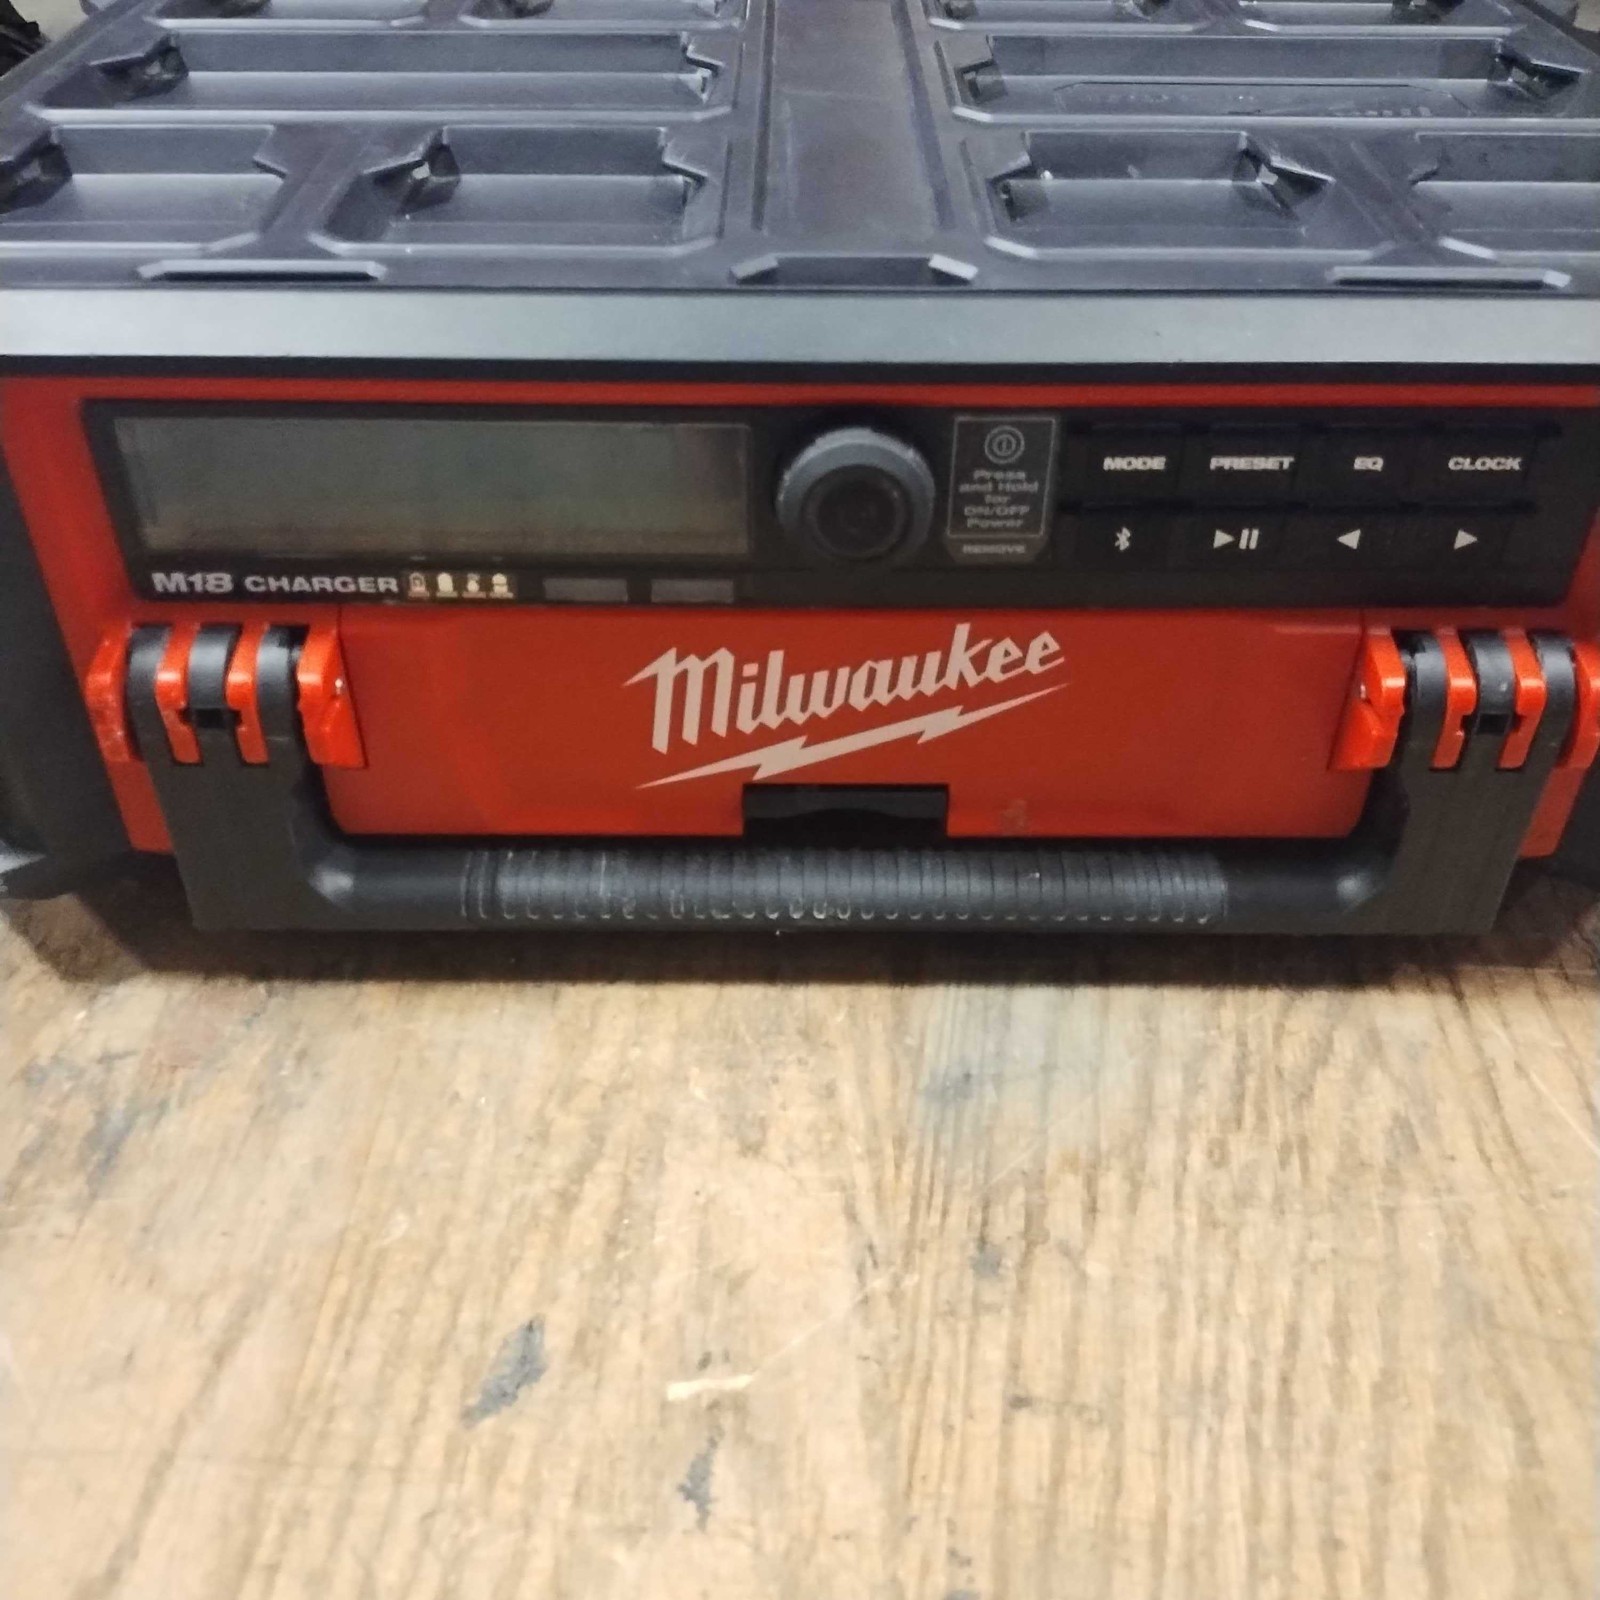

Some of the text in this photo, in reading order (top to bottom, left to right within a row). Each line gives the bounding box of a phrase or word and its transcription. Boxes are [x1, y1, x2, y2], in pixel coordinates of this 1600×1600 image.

[1103, 456, 1167, 471] MODE
[1209, 455, 1295, 471] PRESET
[1353, 456, 1384, 472] EQ
[1447, 456, 1523, 472] CLOCK
[973, 469, 1026, 481] Press
[151, 572, 399, 594] M18 CHARGER
[622, 622, 1065, 755] Milwaukee
